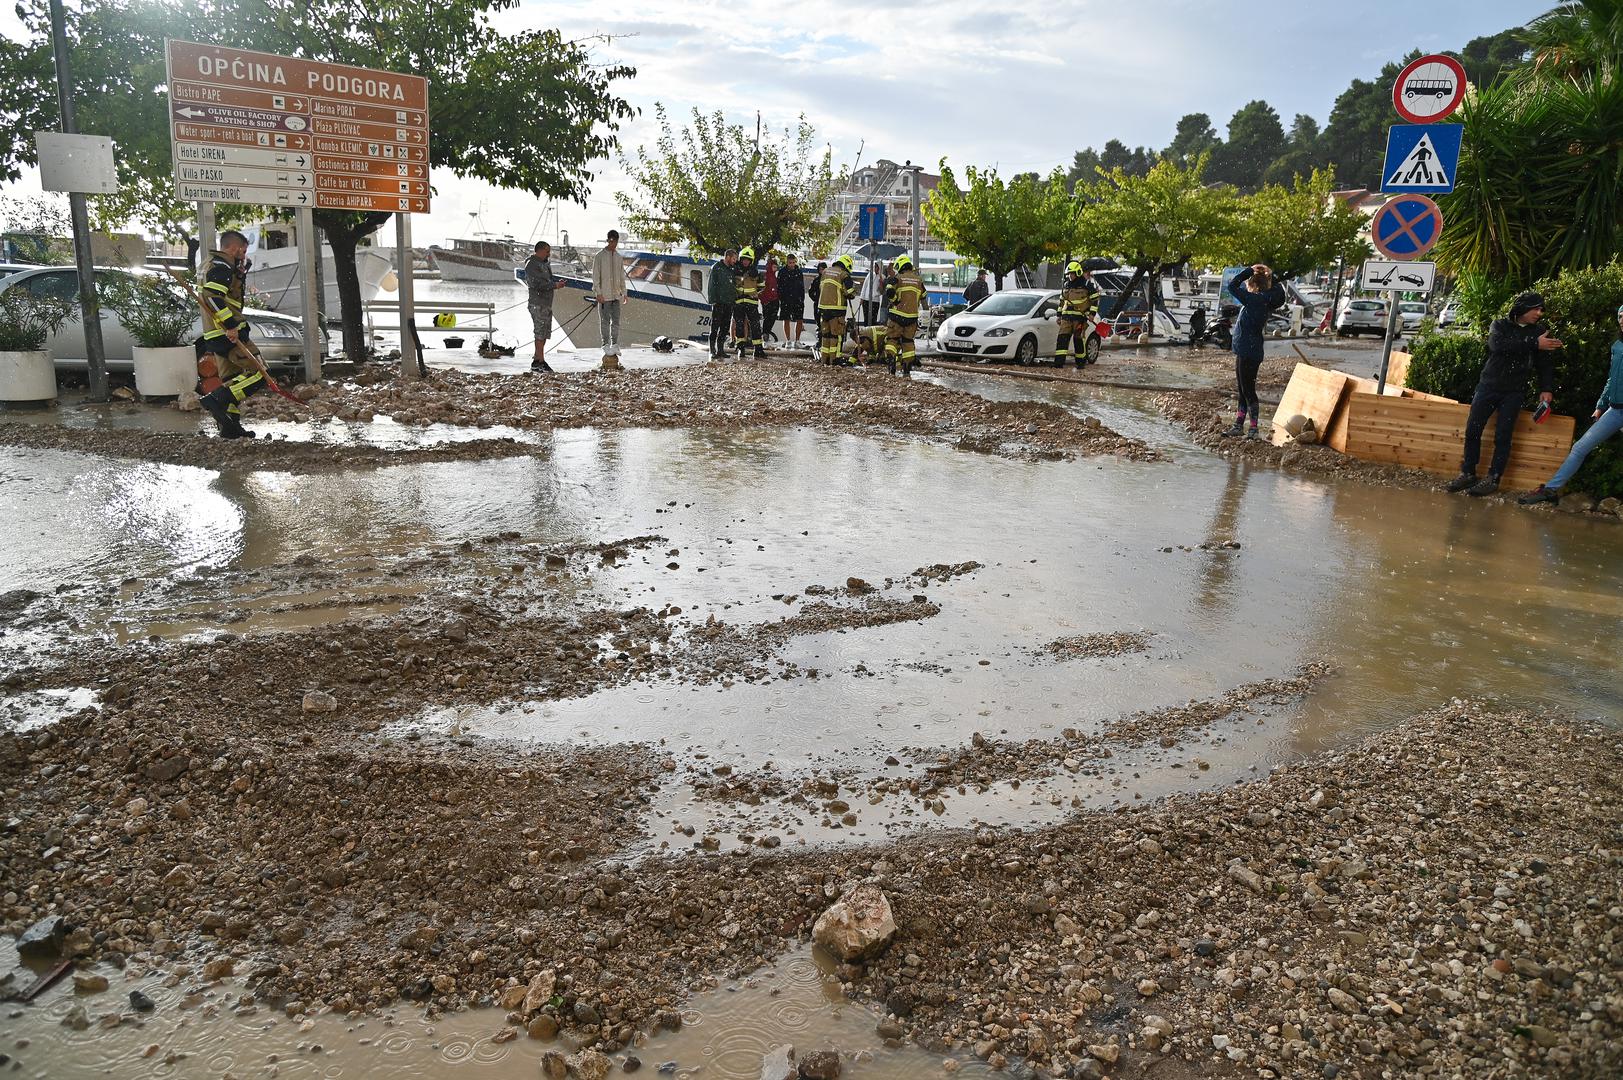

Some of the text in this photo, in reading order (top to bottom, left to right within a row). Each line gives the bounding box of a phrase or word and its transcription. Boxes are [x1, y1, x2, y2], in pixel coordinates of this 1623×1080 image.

[198, 56, 404, 101] OPĆINA PODGORA
[176, 84, 222, 102] Bistro PAPE
[208, 108, 233, 117] OLIVE
[248, 112, 282, 122] FACTORY
[314, 101, 357, 118] Marina PORAT
[213, 116, 248, 126] TASTING
[256, 121, 277, 129] SHOP
[315, 120, 333, 133] Plaža
[180, 125, 198, 137] Water
[200, 128, 216, 140] sport
[222, 130, 235, 141] rent
[236, 133, 240, 141] a
[241, 131, 254, 142] boat
[180, 146, 226, 160] Hotel SIRENA
[316, 140, 339, 152] Konoba
[317, 157, 369, 172] Gostionica RIBAR
[182, 167, 198, 180] Villa
[319, 176, 367, 190] Caffe bar VELA
[184, 186, 220, 199] Apartmani
[319, 193, 373, 208] Pizzeria AHIPARA
